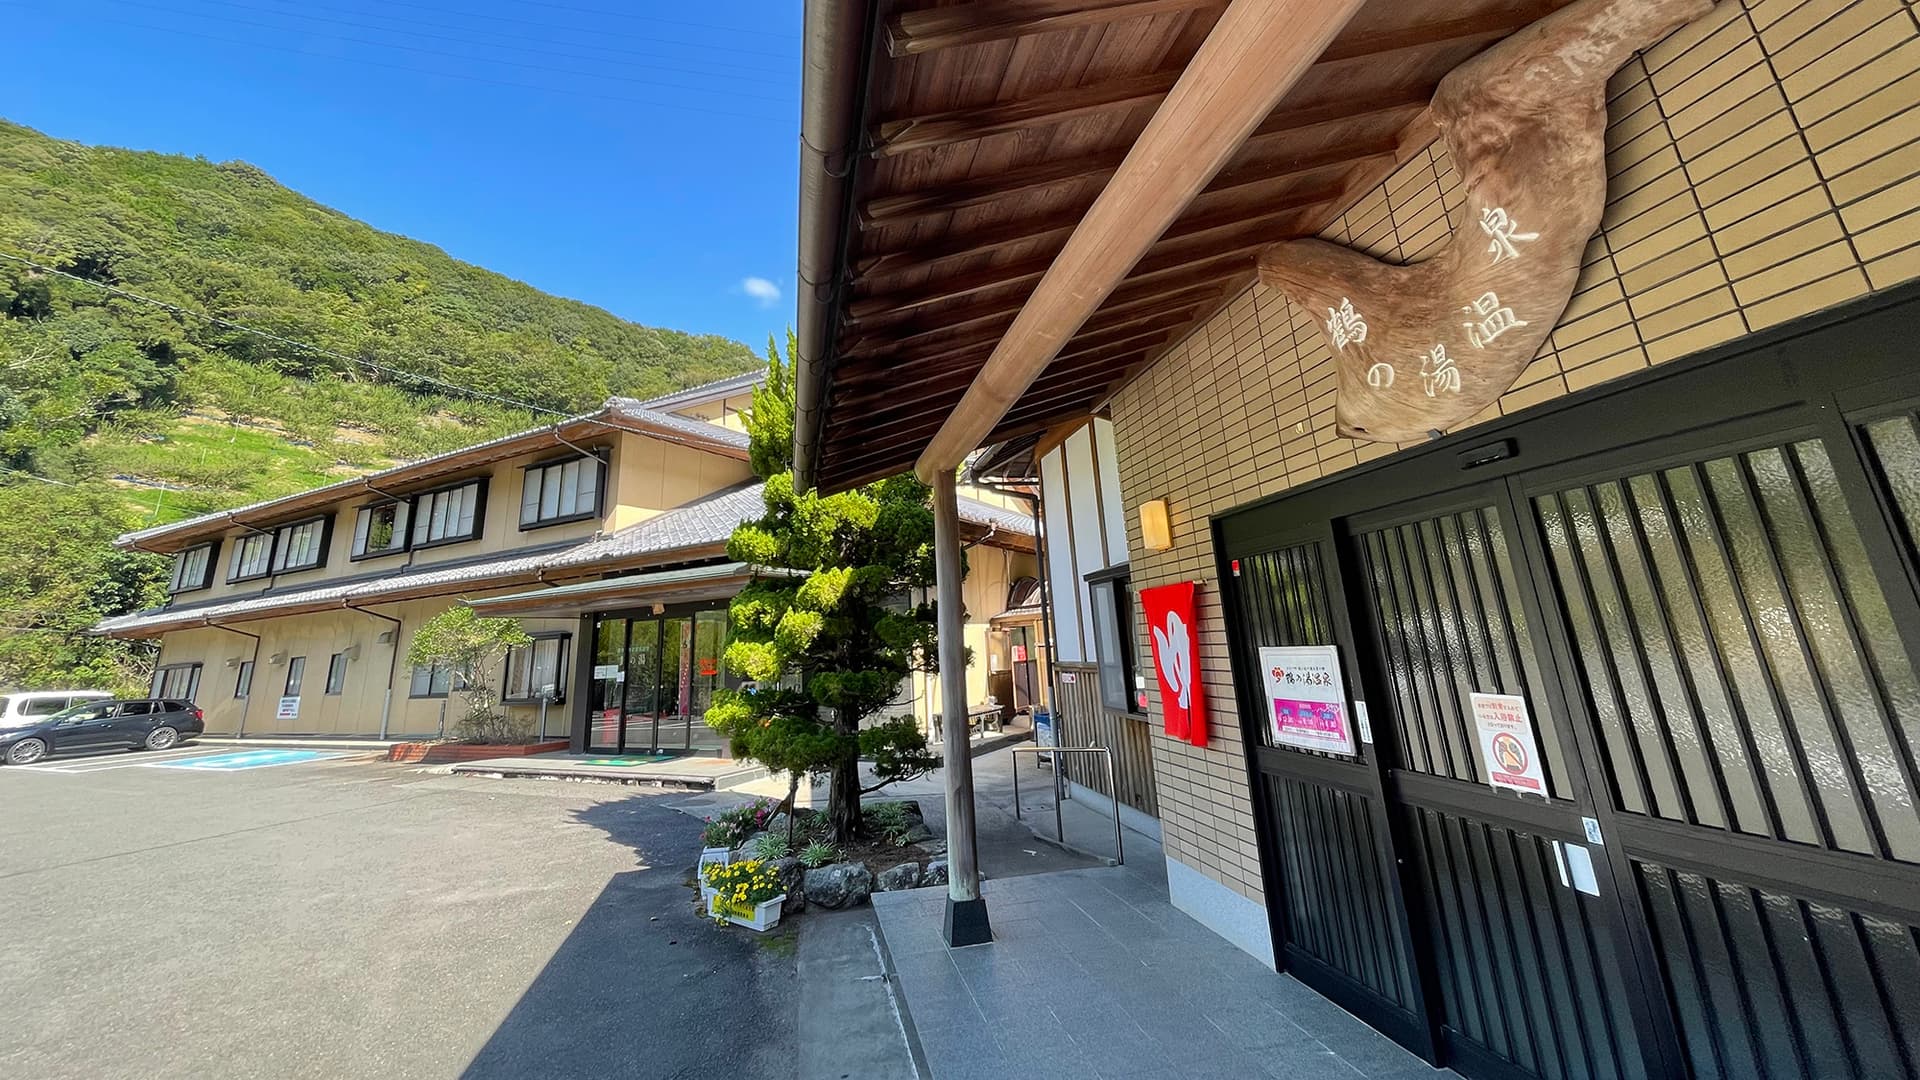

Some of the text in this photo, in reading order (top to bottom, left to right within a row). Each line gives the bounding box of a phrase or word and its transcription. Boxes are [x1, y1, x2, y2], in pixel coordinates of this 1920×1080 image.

[1326, 207, 1539, 397] 鶴の湯温泉
[1153, 610, 1191, 709] ゆ
